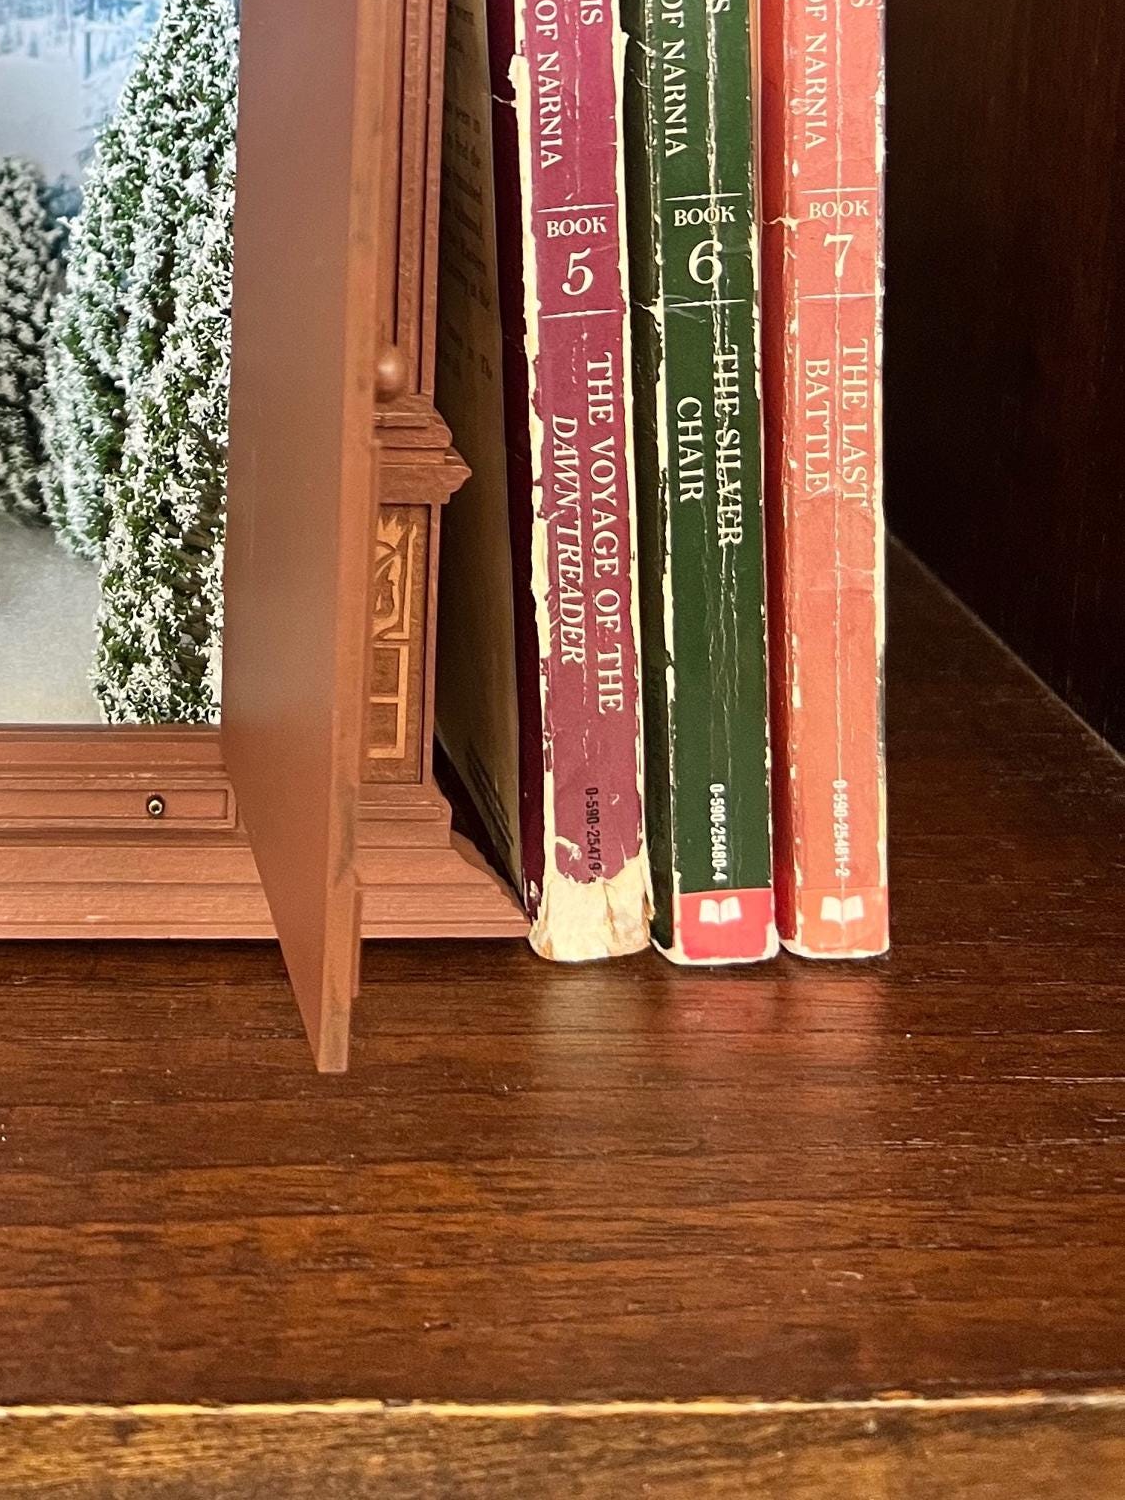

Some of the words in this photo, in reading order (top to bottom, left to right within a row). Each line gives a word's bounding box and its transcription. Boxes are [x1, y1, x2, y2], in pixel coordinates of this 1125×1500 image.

[534, 0, 559, 40] OF
[535, 52, 564, 169] NARNIA
[660, 39, 687, 158] NARNIA
[803, 34, 827, 150] NARNIA
[546, 216, 607, 238] BOOK
[673, 206, 736, 227] BOOK
[809, 199, 870, 220] BOOK
[562, 247, 594, 296] 5
[688, 240, 724, 285] 6
[823, 234, 853, 278] 7
[586, 351, 614, 426] THE
[713, 346, 739, 417] THE
[842, 338, 868, 412] THE
[551, 414, 581, 505] DAWN
[676, 396, 705, 503] CHAIR
[804, 358, 831, 496] BATTLE
[842, 422, 869, 509] LAST
[588, 436, 620, 577] VOYAGE
[716, 428, 744, 547] SILVER
[552, 516, 586, 665] TREADER
[594, 586, 622, 640] OF
[597, 651, 624, 715] THE
[709, 783, 727, 882] 0-590-25480-4
[832, 780, 849, 878] 0-590-25481-2
